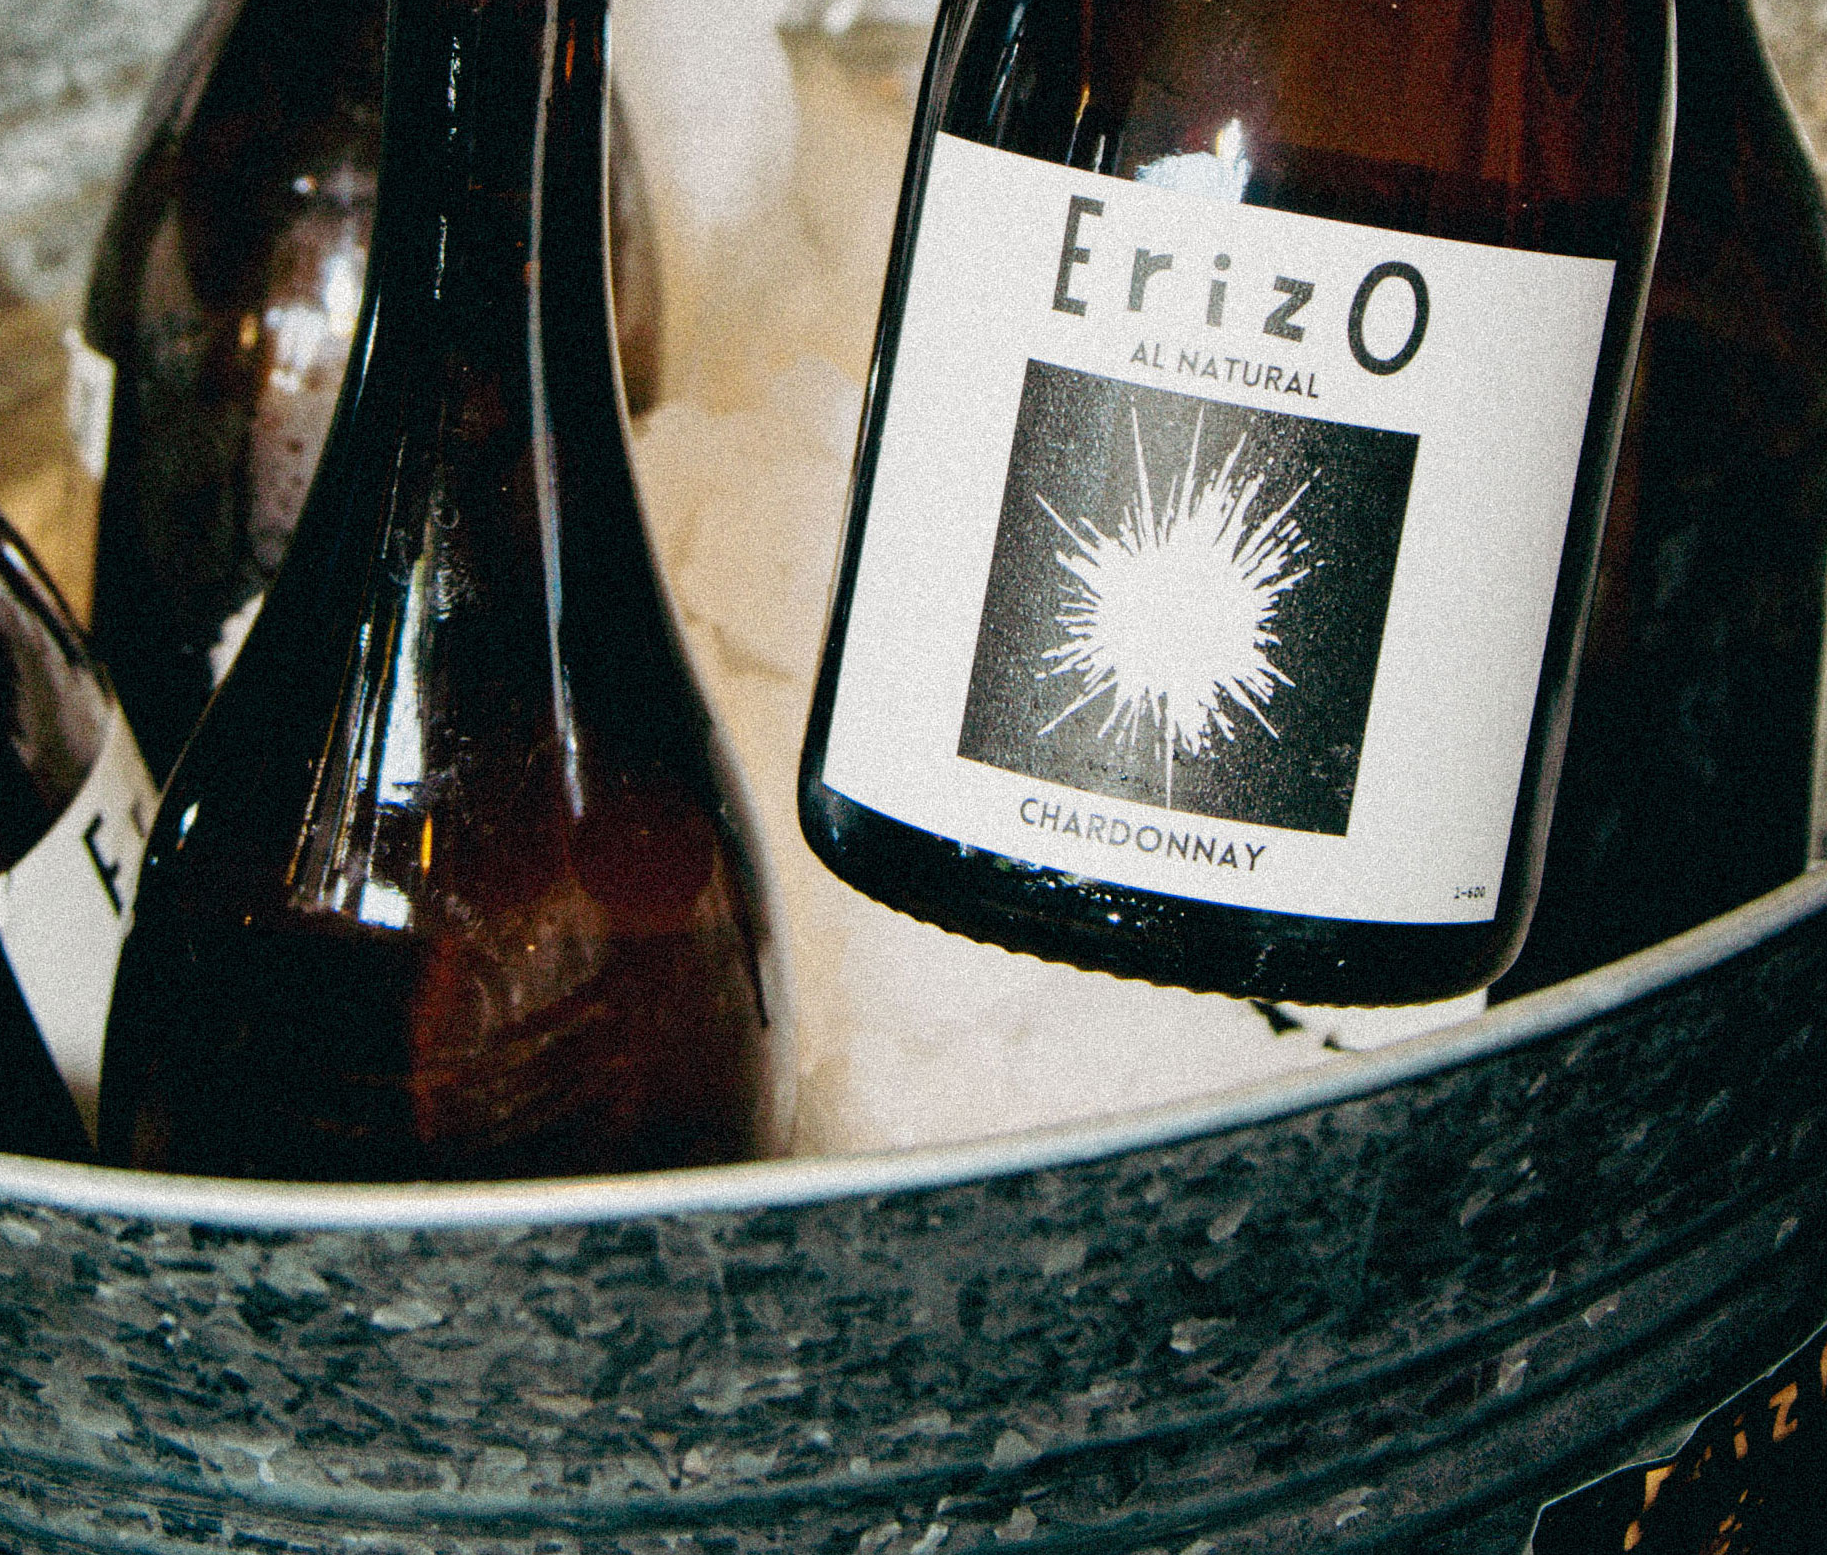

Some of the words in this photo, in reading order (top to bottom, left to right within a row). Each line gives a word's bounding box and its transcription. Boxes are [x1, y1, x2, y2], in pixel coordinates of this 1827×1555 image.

[1052, 195, 1430, 376] ErizO
[1129, 340, 1165, 370] AL
[1178, 349, 1319, 399] NATURAL
[1020, 798, 1267, 872] CHARDONNAY
